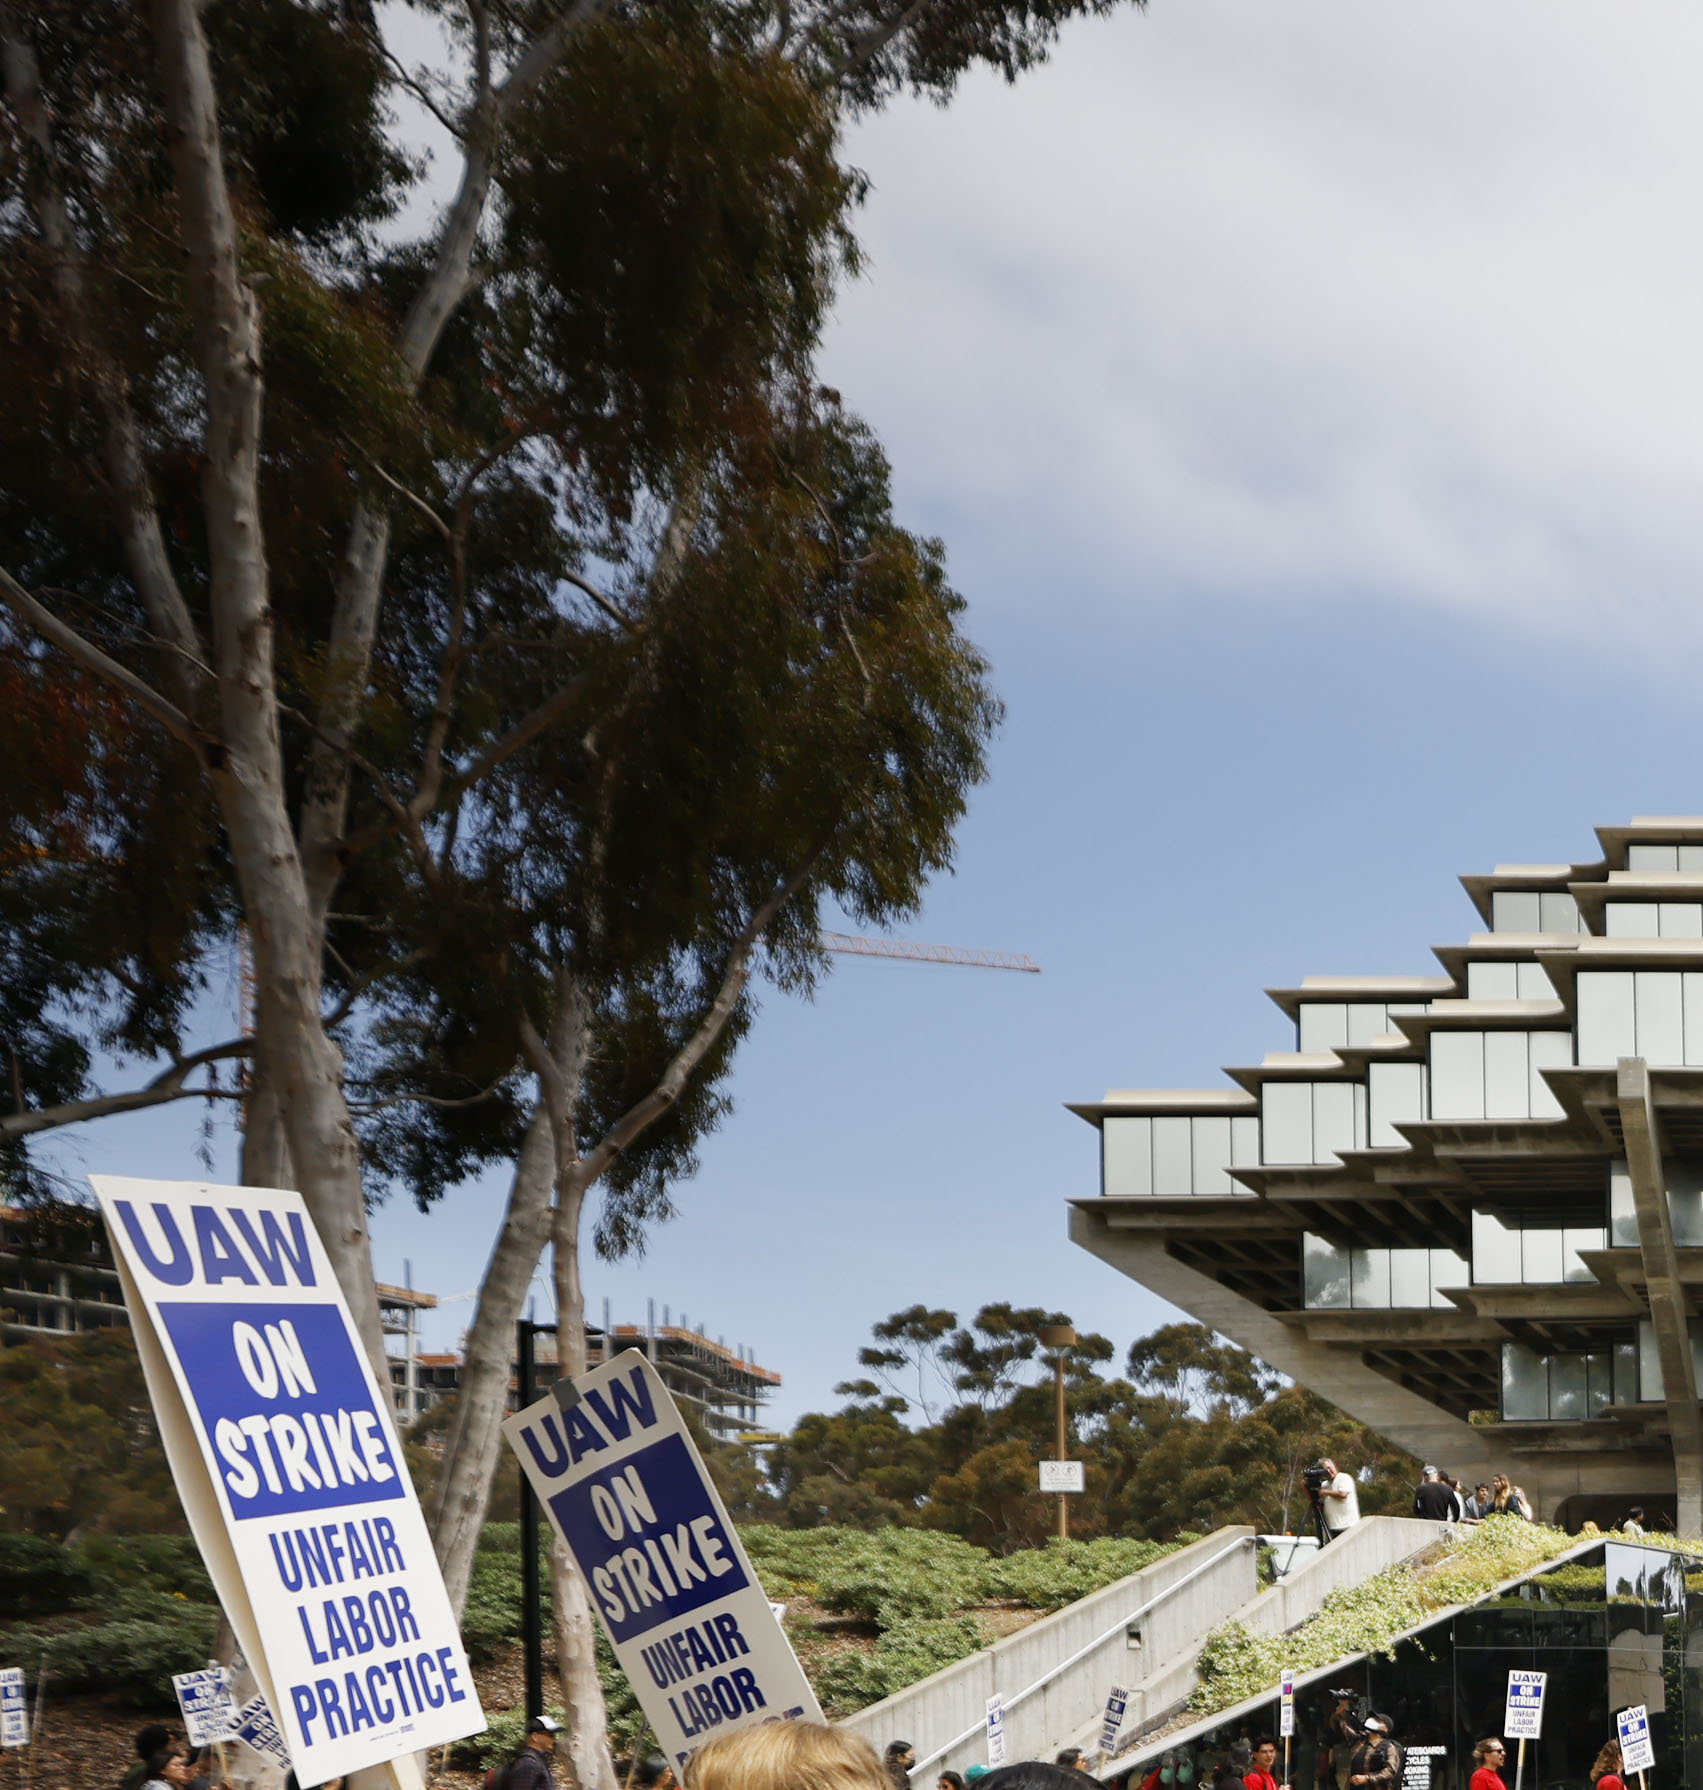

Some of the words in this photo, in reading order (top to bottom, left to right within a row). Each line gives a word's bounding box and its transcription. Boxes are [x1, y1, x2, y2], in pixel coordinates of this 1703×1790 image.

[114, 1200, 316, 1286] UAW
[233, 1319, 317, 1399] ON
[520, 1365, 657, 1478] UAW
[215, 1408, 394, 1499] STRIKE
[590, 1465, 657, 1541] ON
[269, 1517, 406, 1592] UNFAIR
[592, 1515, 733, 1623] STRIKE
[297, 1586, 421, 1665] LABOR
[641, 1613, 750, 1690] UNFAIR
[176, 1669, 222, 1686] UAW
[1512, 1673, 1542, 1682] UAW
[290, 1646, 465, 1747] PRACTICE
[1520, 1685, 1532, 1696] ON
[668, 1667, 766, 1738] LABOR
[1509, 1696, 1540, 1707] STRIKE
[228, 1694, 266, 1730] UAW
[1512, 1710, 1535, 1718] UNFAIR
[1619, 1709, 1643, 1724] UAW
[1508, 1726, 1537, 1734] PRACTICE
[1513, 1718, 1534, 1726] LABOR
[1628, 1722, 1639, 1734] ON
[1622, 1729, 1647, 1745] STRIKE
[1403, 1746, 1447, 1755] ATEBOARDS
[1630, 1751, 1646, 1761] LABOR
[1627, 1757, 1651, 1770] PRACTICE
